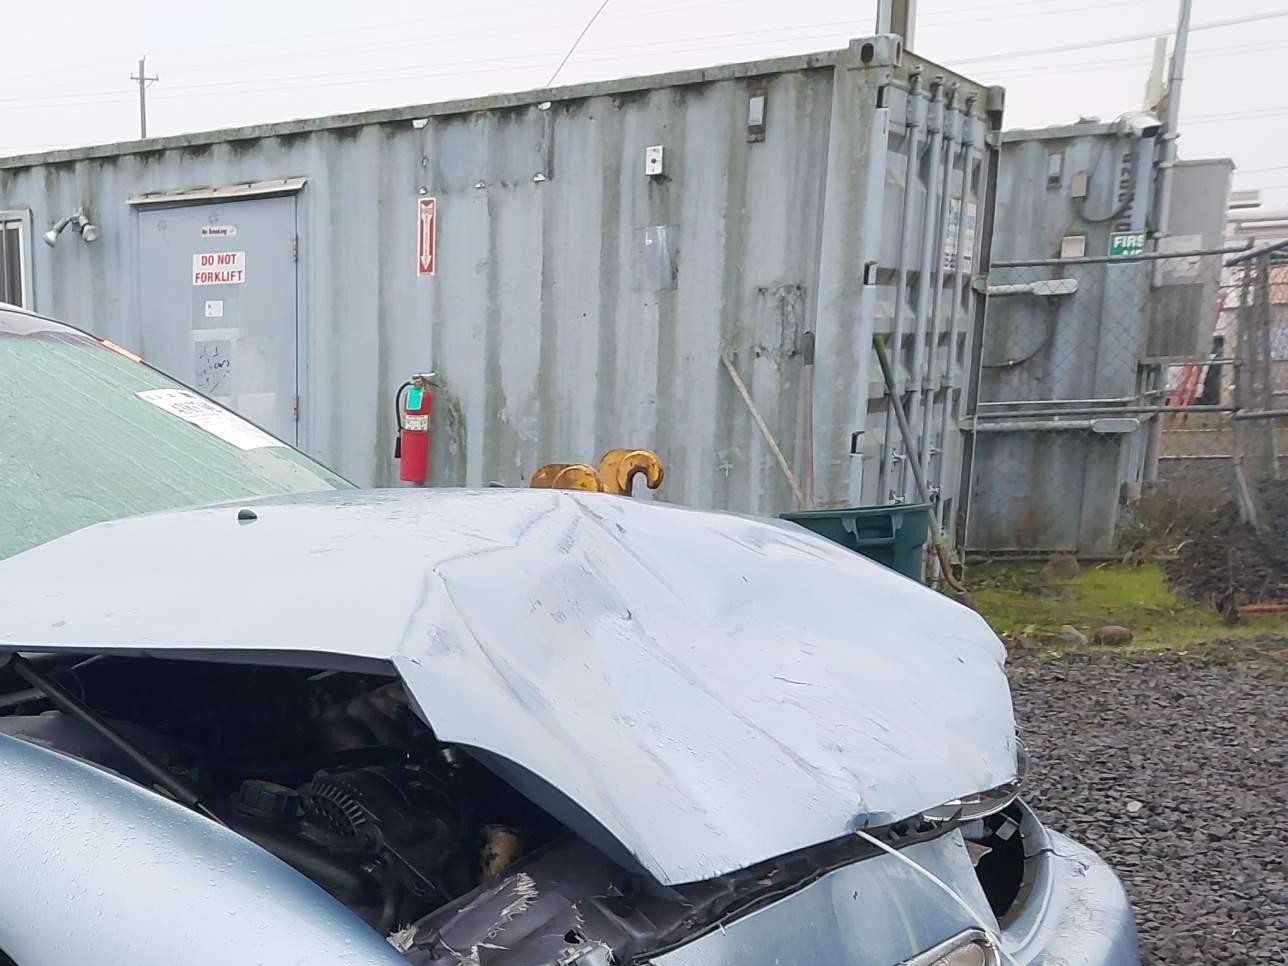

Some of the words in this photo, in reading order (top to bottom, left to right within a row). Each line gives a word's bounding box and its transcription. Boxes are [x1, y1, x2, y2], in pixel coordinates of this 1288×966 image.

[201, 255, 215, 266] DO
[217, 253, 237, 265] NOT
[195, 270, 243, 283] FORKLIFT
